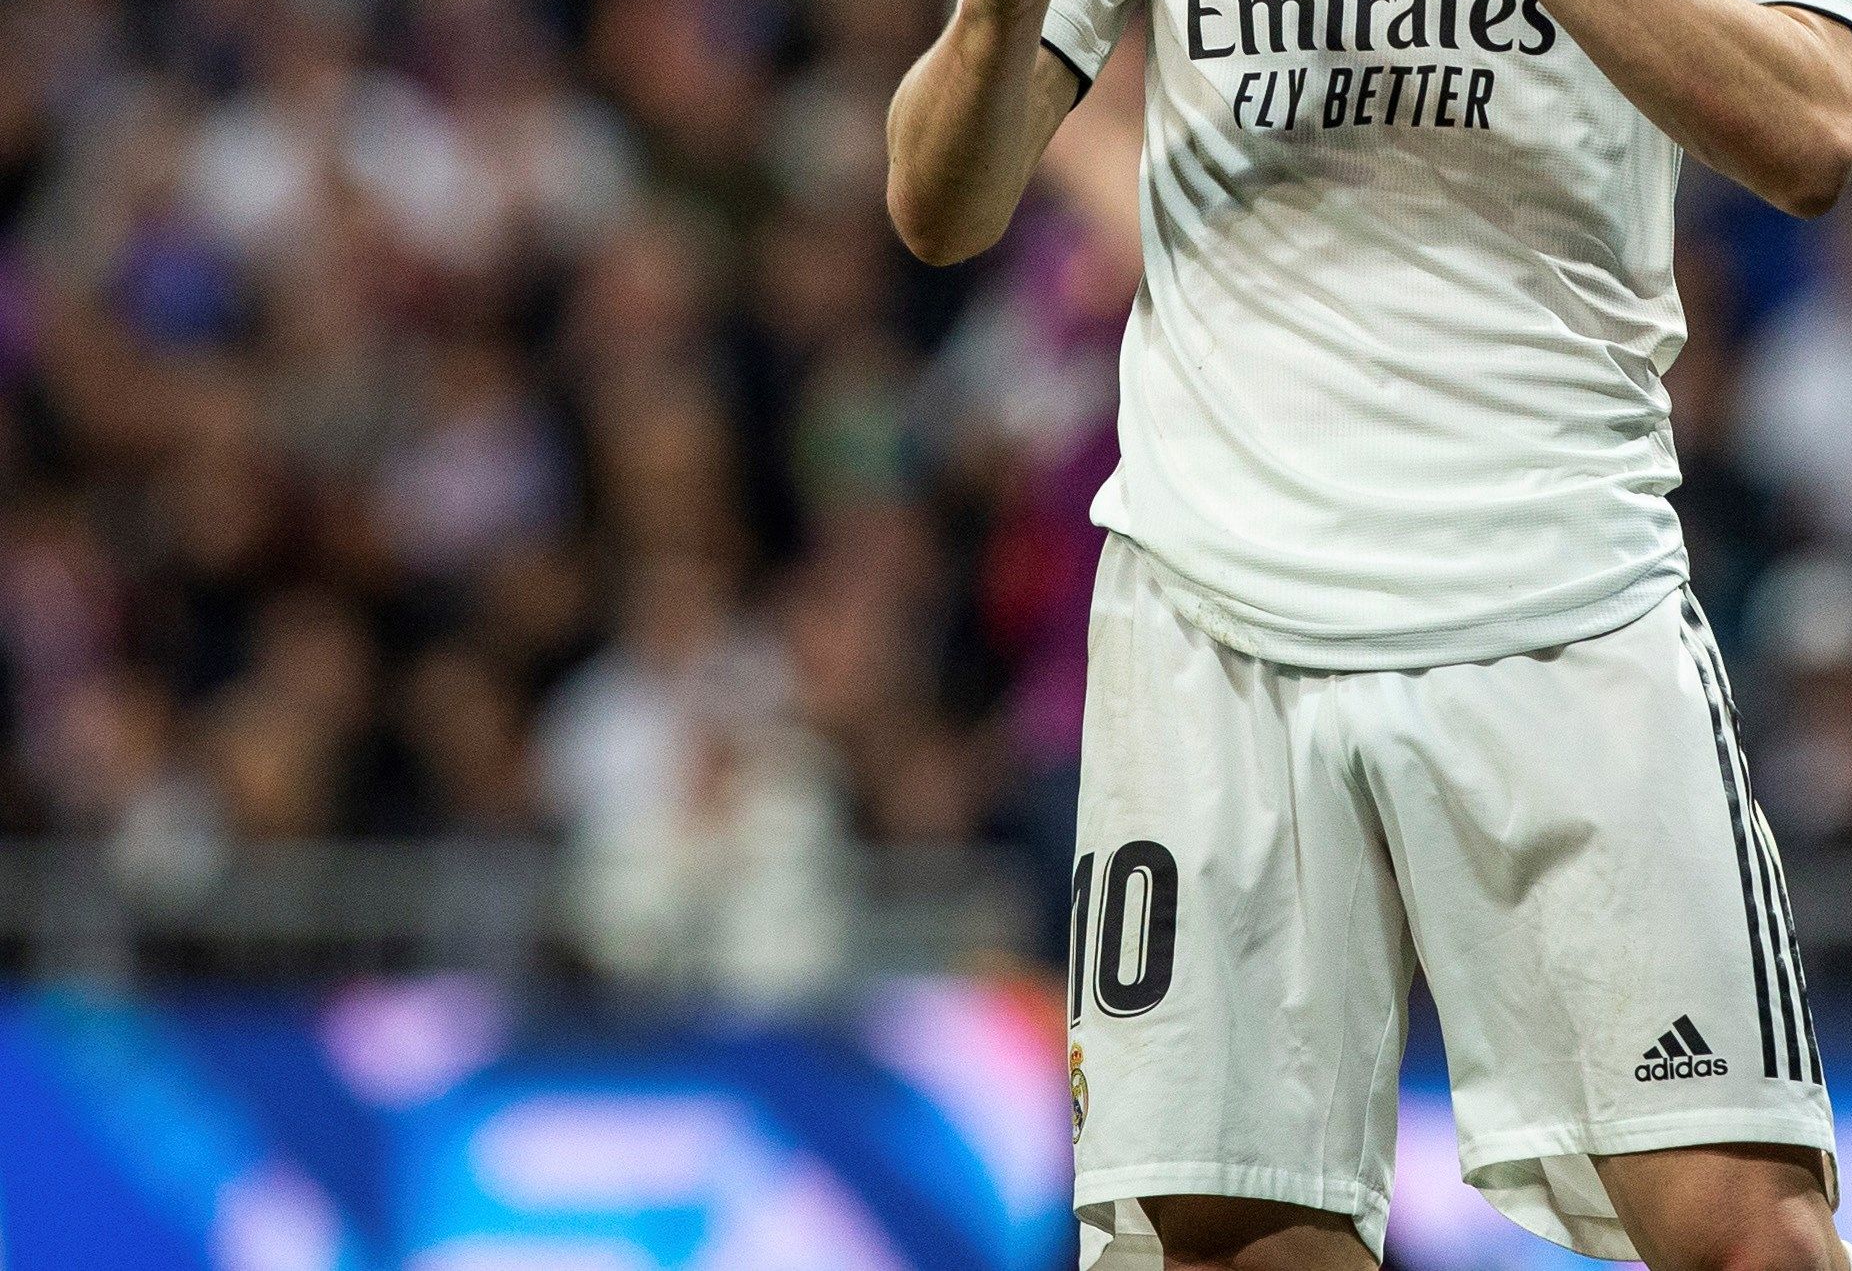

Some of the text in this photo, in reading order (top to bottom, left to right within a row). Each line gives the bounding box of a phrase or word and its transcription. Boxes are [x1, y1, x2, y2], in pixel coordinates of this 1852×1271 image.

[1232, 64, 1495, 130] FLY BETTER
[1070, 839, 1179, 1029] 10
[1634, 1055, 1729, 1082] adidas
